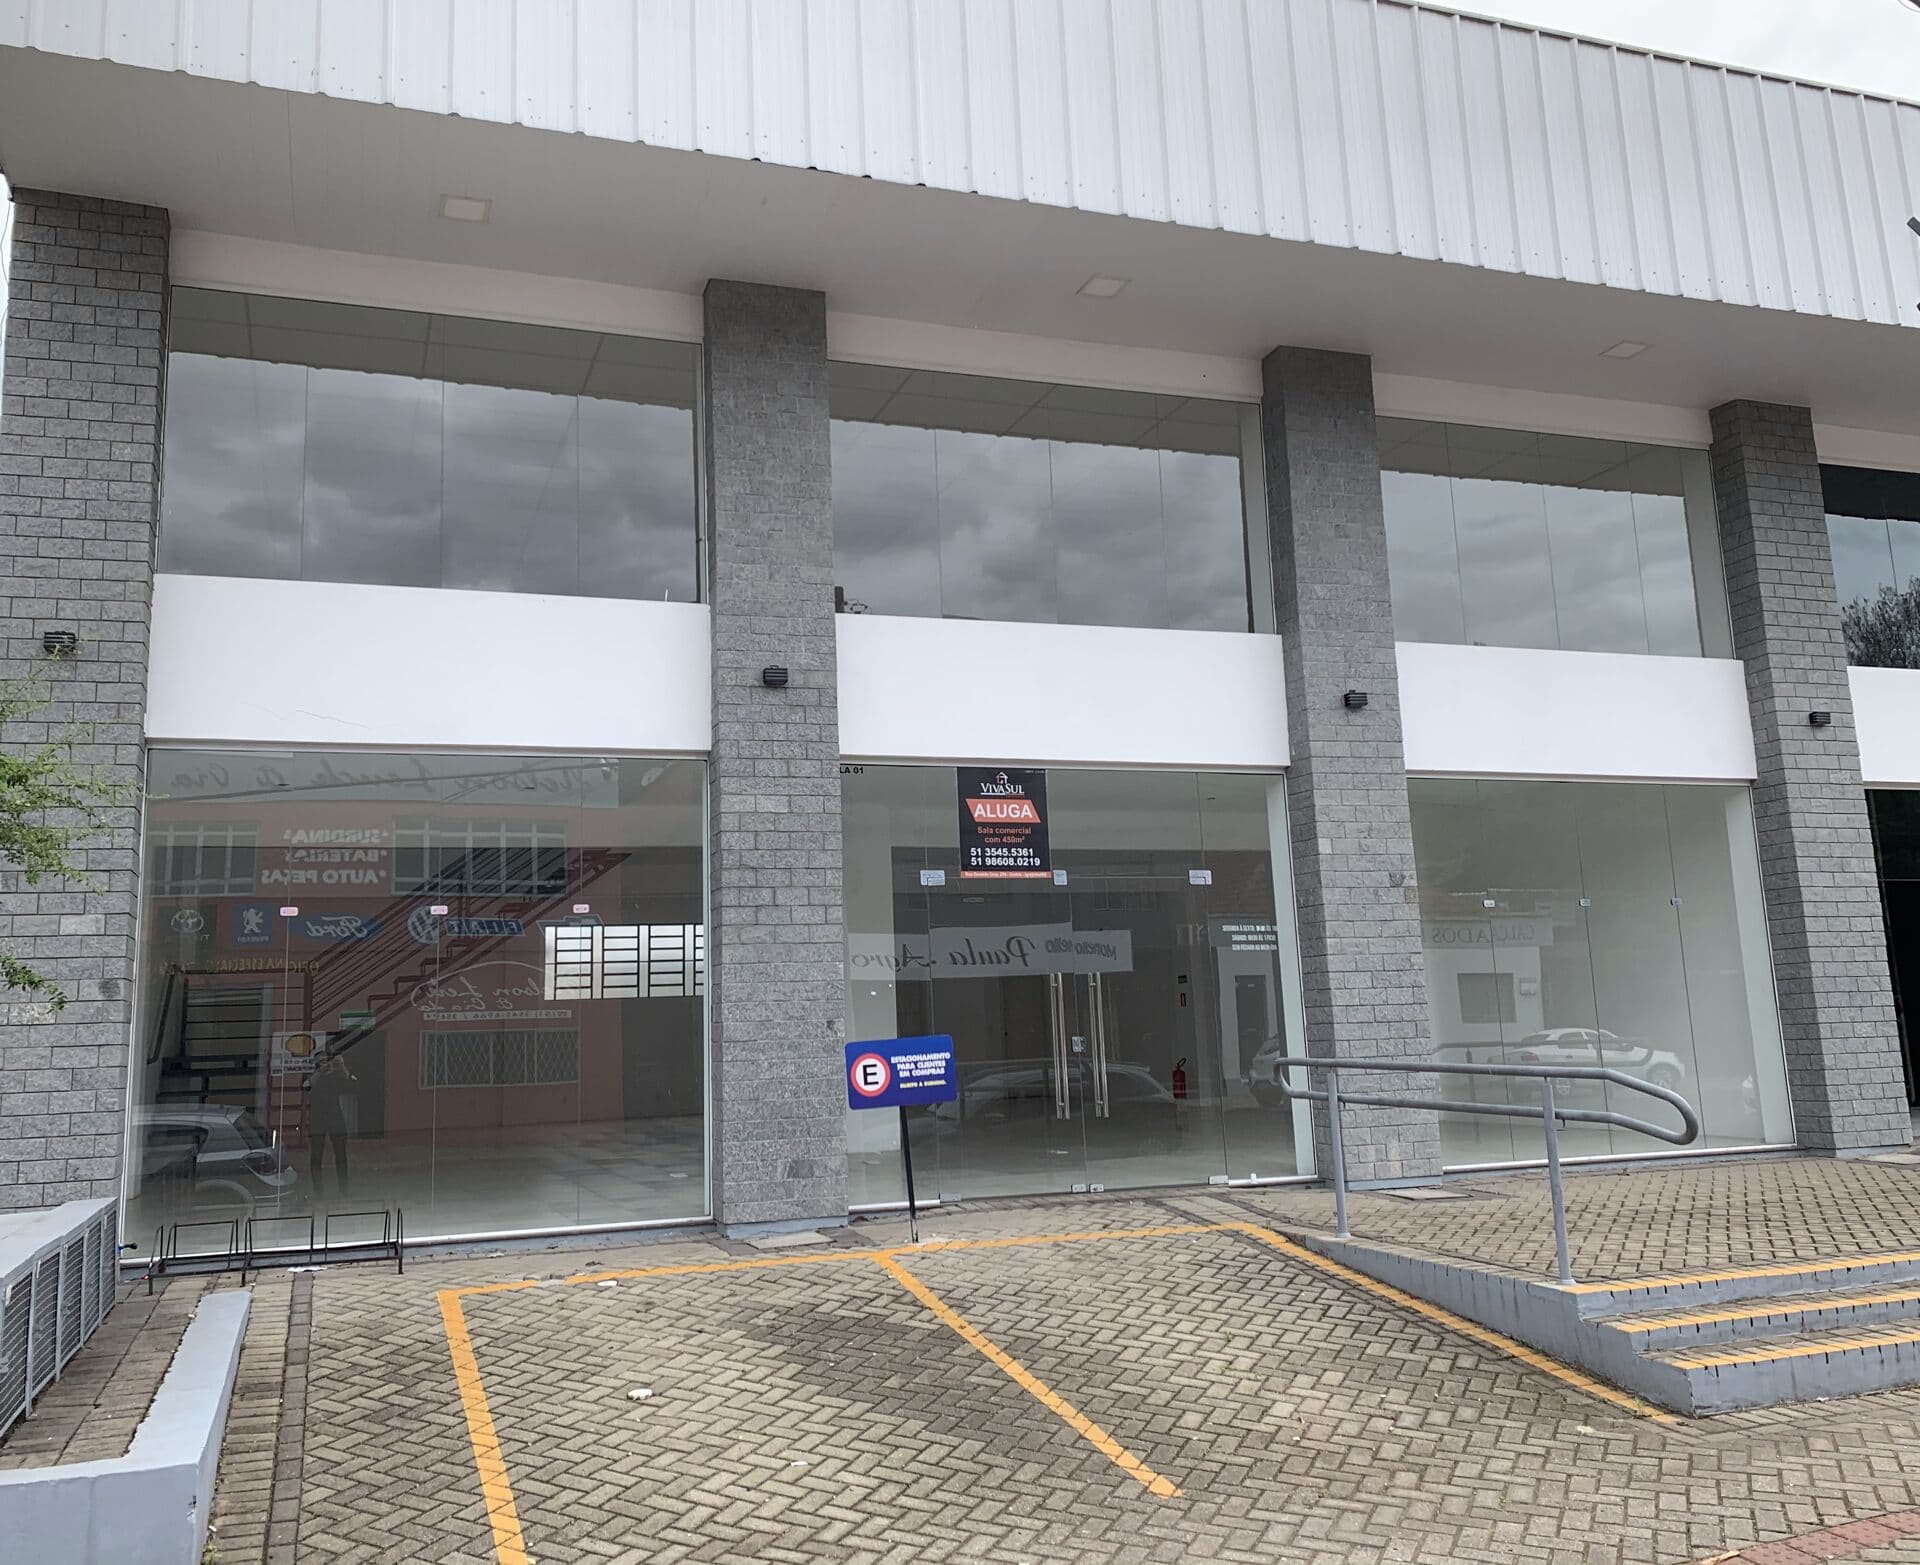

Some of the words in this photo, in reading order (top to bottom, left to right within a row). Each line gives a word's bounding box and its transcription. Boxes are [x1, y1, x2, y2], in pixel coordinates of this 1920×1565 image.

[839, 765, 851, 774] LA
[852, 766, 864, 775] 01
[974, 803, 1033, 818] ALUGA
[977, 826, 994, 835] Sala
[995, 826, 1032, 835] comercial
[970, 847, 982, 858] 51
[985, 847, 1034, 858] 3545.5361
[971, 857, 982, 867] 51
[985, 857, 1041, 867] 98608.0219
[890, 1052, 951, 1064] ESTACIONAMENTO
[897, 1062, 916, 1071] PARA
[917, 1060, 946, 1069] CLIENTES
[862, 1064, 879, 1086] E
[899, 1070, 911, 1078] EM
[912, 1068, 945, 1077] COMPRAS
